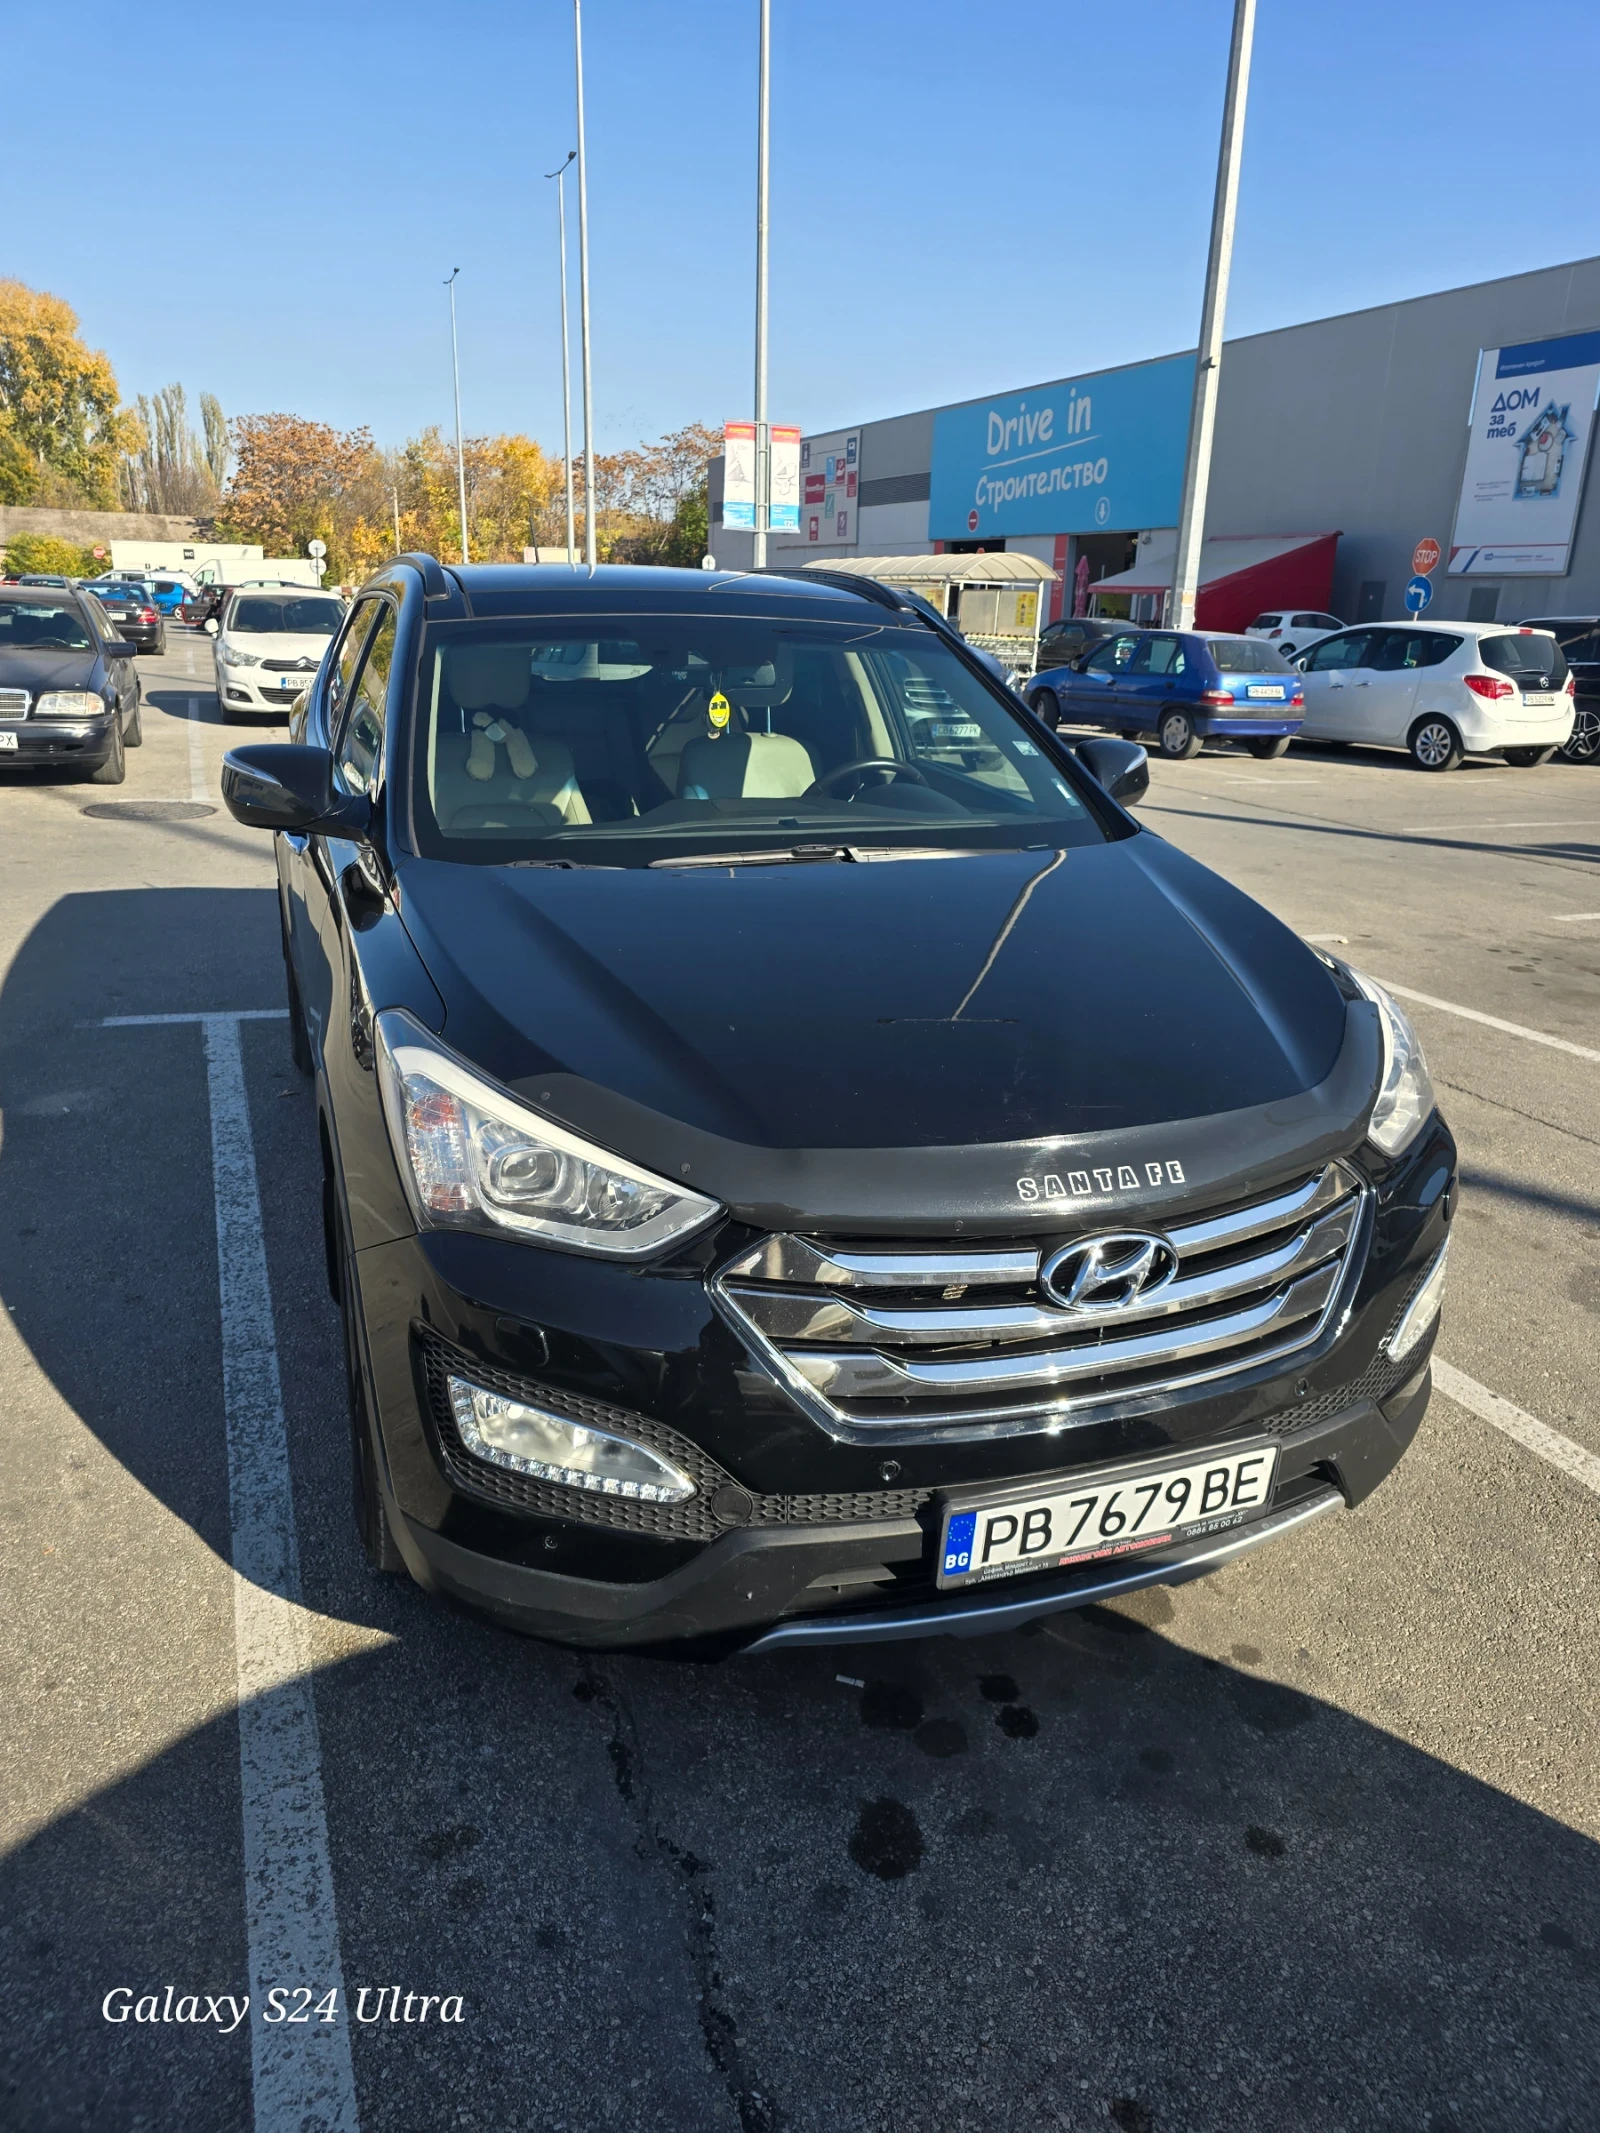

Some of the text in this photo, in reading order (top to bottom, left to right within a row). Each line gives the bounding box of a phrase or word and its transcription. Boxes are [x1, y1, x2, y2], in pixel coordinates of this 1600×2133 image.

[1490, 387, 1540, 413] ДОМ
[987, 387, 1091, 455] Drive in
[1489, 414, 1505, 426] за
[1486, 422, 1517, 439] теб
[975, 457, 1108, 513] Строителство
[1415, 550, 1437, 564] STOP
[287, 679, 298, 687] PB
[949, 725, 969, 735] 6277
[1016, 1160, 1186, 1200] SANTA FE
[981, 1457, 1265, 1563] PB 7679 BE
[1220, 1520, 1231, 1528] 00
[945, 1552, 969, 1569] BG
